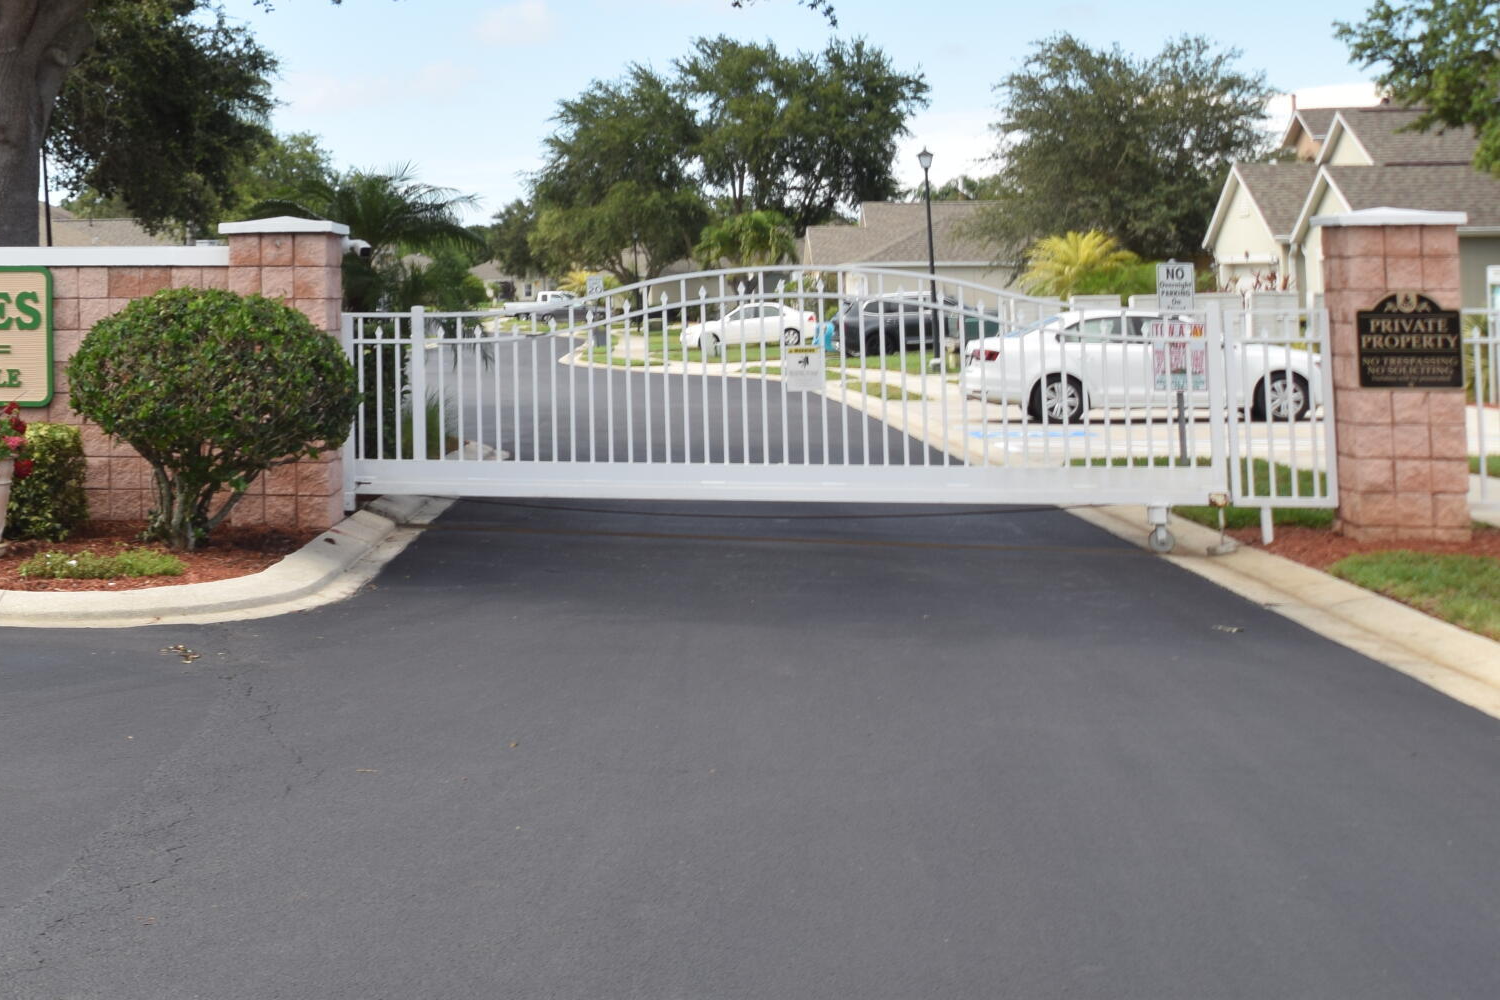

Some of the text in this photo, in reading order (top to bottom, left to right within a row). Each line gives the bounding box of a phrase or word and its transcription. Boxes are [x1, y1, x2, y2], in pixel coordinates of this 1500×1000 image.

[1165, 267, 1185, 281] NO
[1161, 289, 1191, 297] PARKING
[1369, 319, 1448, 333] PRIVATE
[1361, 334, 1458, 349] PROPERTY
[1362, 357, 1381, 366] NO
[1367, 367, 1454, 376] NO SOLICITING
